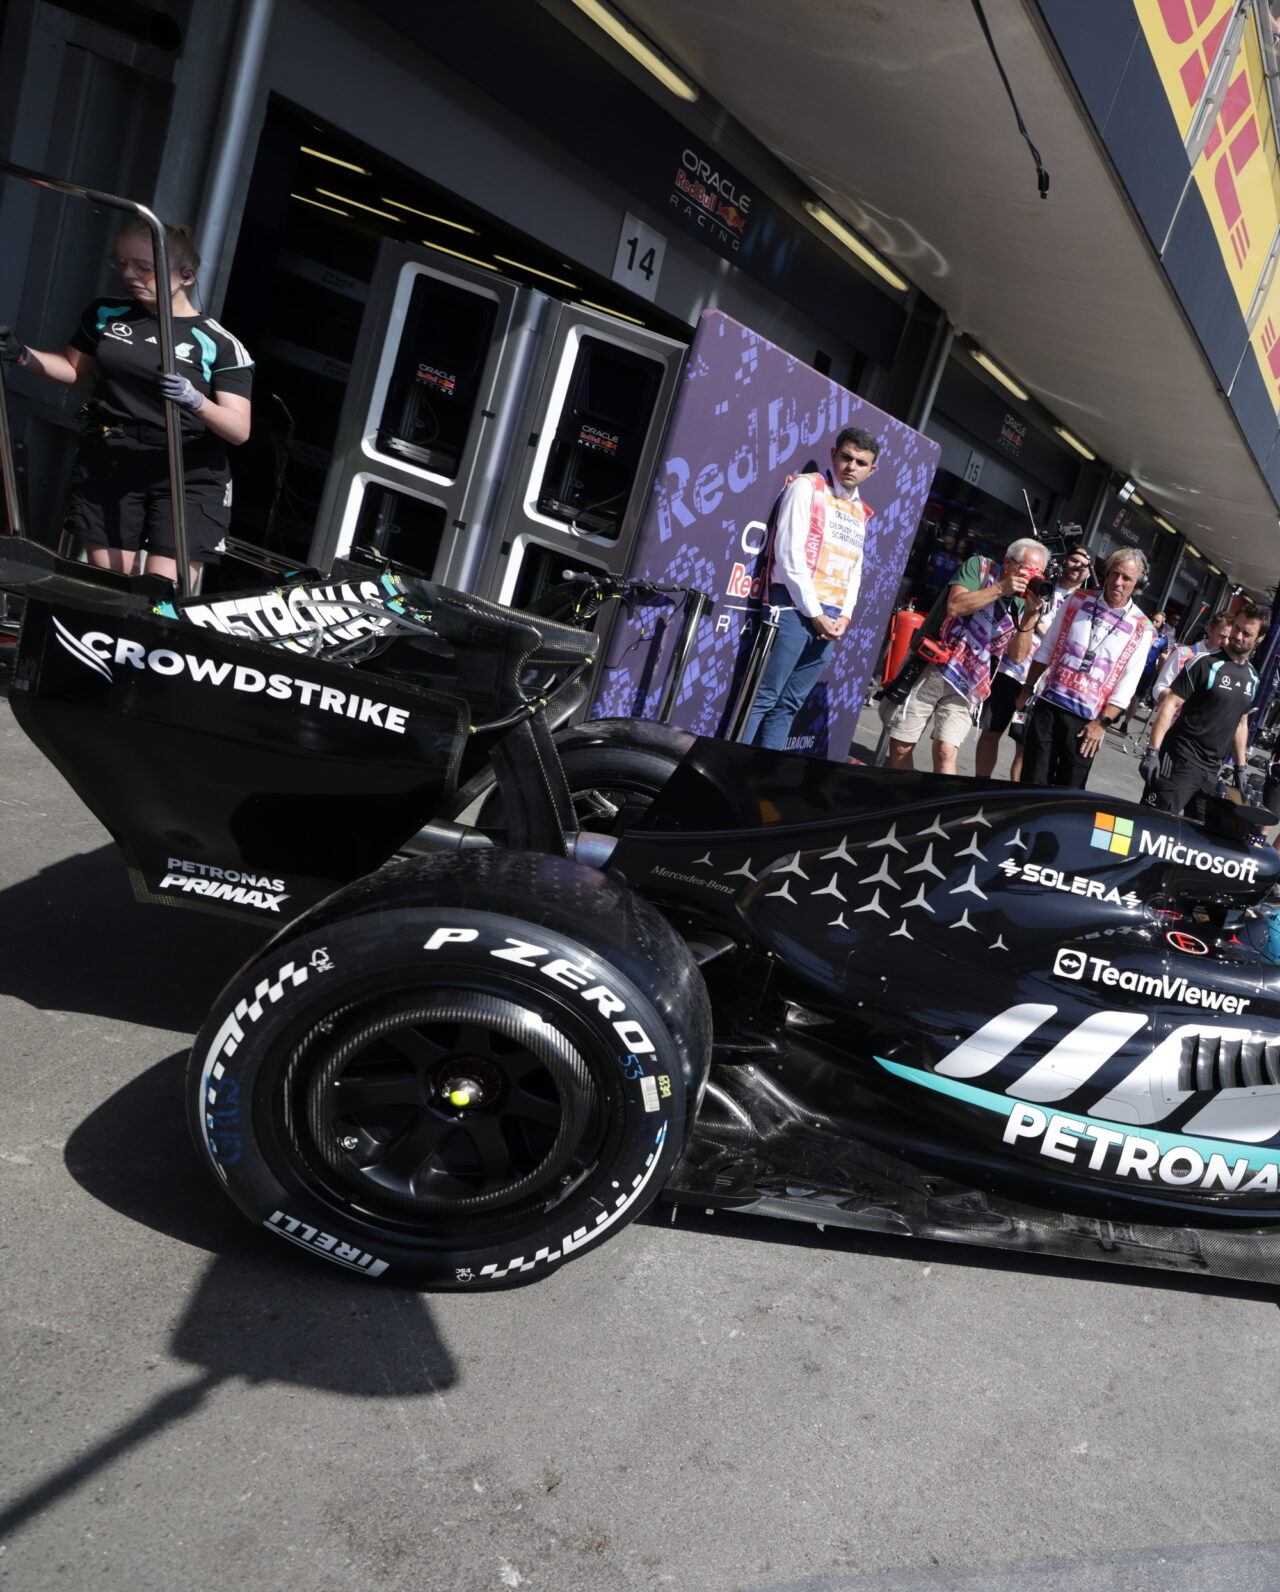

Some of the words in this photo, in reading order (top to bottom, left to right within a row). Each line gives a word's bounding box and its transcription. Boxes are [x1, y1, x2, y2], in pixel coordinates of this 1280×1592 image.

[682, 149, 751, 214] ORACLE
[670, 194, 740, 251] RACING
[627, 237, 656, 281] 14
[419, 363, 456, 381] ORACLE
[582, 425, 619, 442] ORACLE
[968, 461, 982, 483] 15
[81, 631, 410, 734] CROWDSTRIKE
[167, 858, 285, 892] PETRONAS
[1139, 830, 1259, 884] Microsoft
[159, 874, 291, 912] PRIMAX
[651, 865, 735, 895] Mercedes-Benz
[1021, 864, 1122, 906] SOLERA
[423, 928, 479, 949] P
[490, 938, 655, 1054] ZERO
[1089, 957, 1251, 1015] TeamViewer
[263, 1210, 390, 1278] PIRELLI
